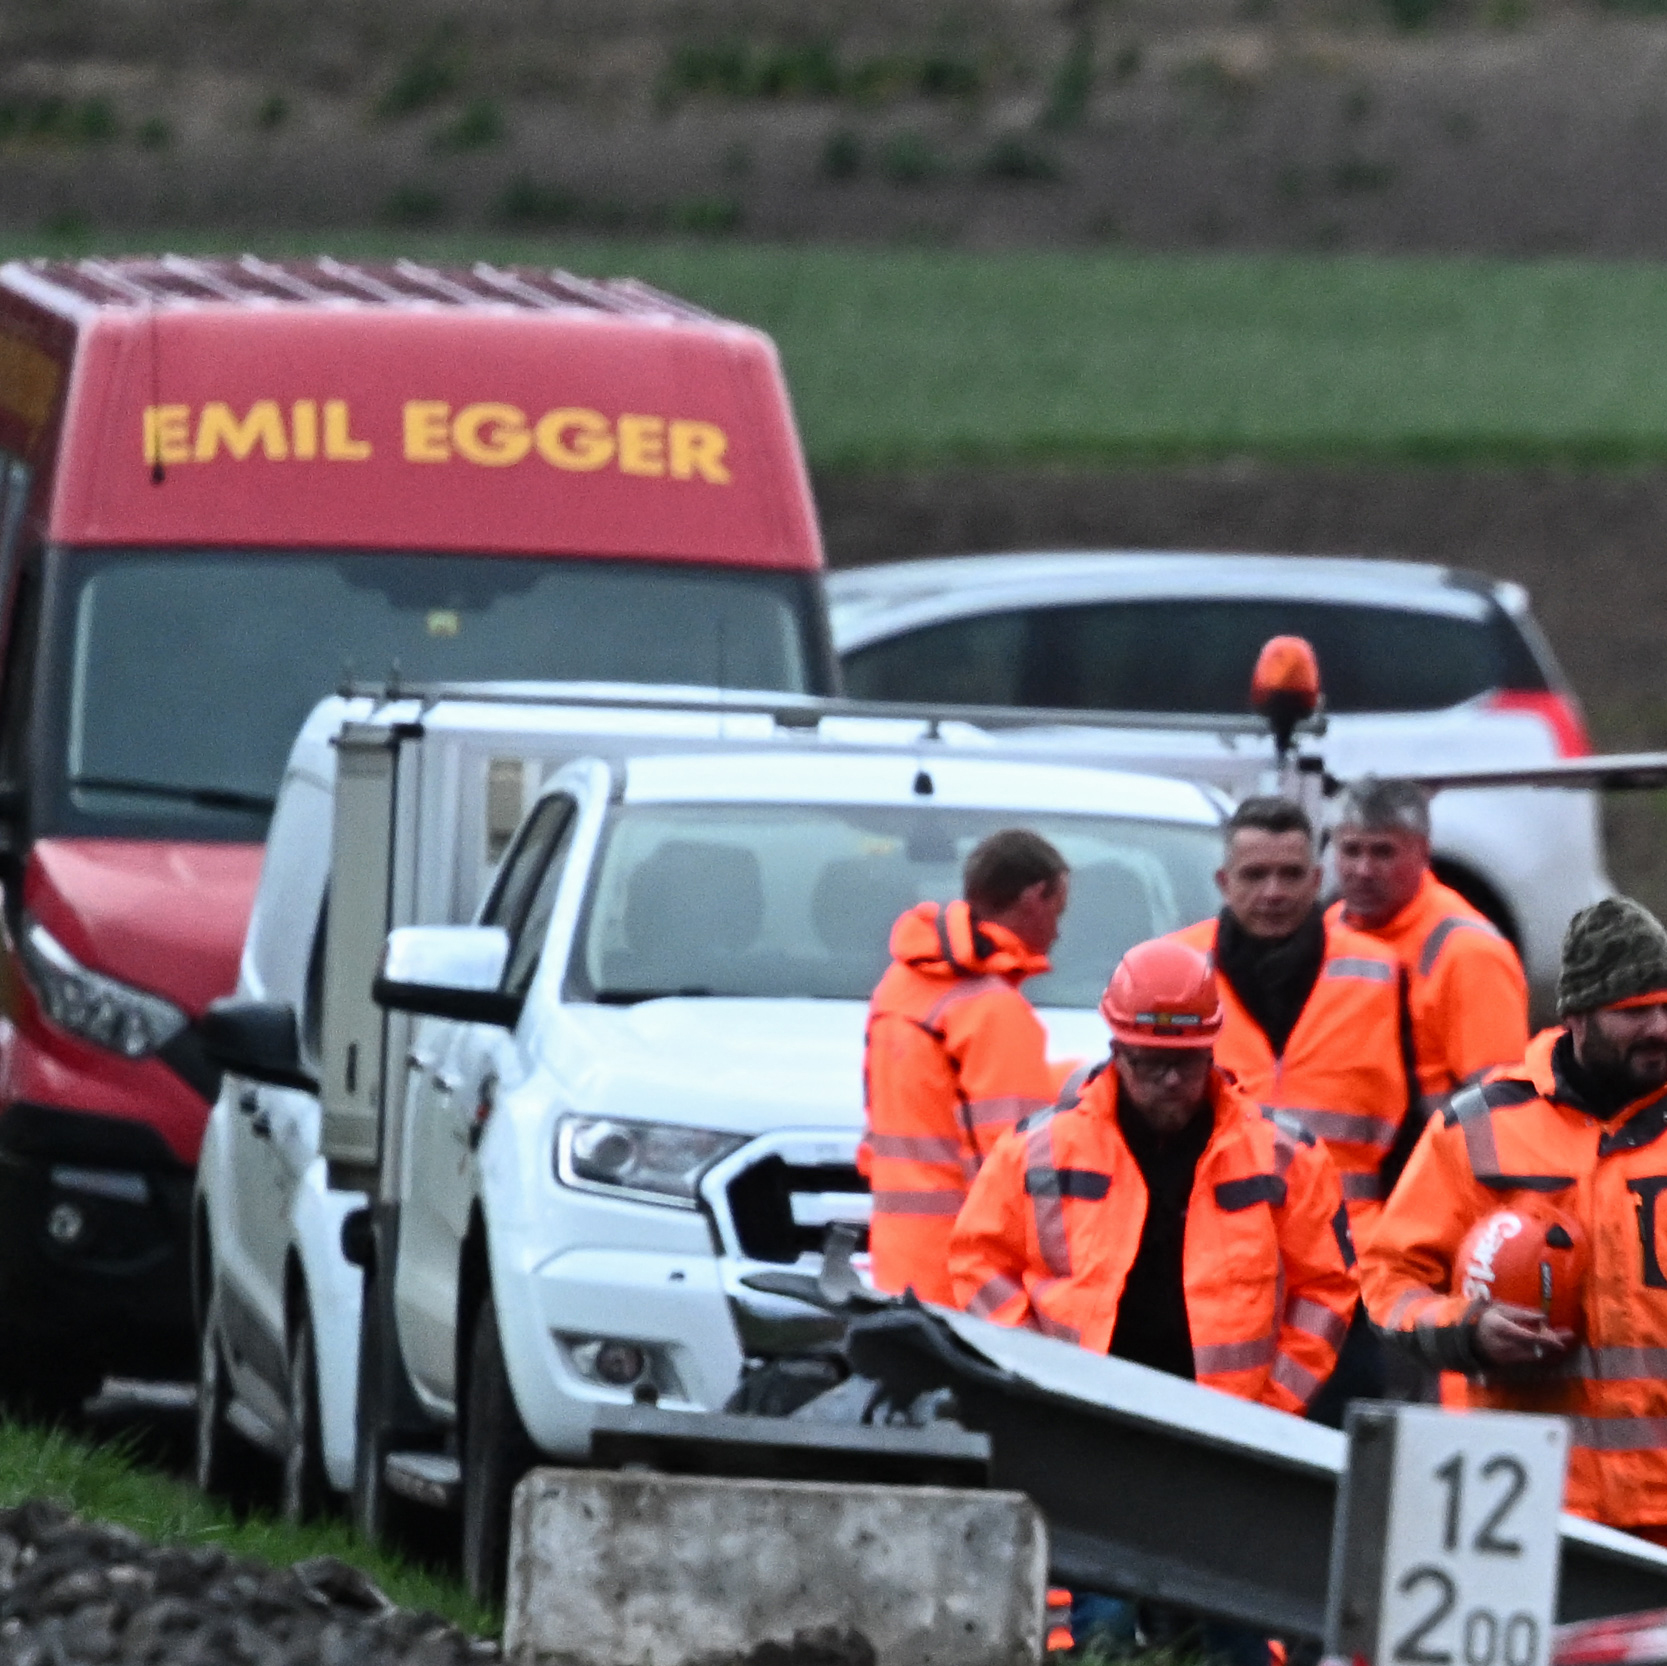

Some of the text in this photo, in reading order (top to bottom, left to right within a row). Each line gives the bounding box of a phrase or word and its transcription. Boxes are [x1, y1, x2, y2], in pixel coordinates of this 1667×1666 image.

[142, 399, 733, 485] EMIL EGGER
[1434, 1452, 1528, 1559] 12
